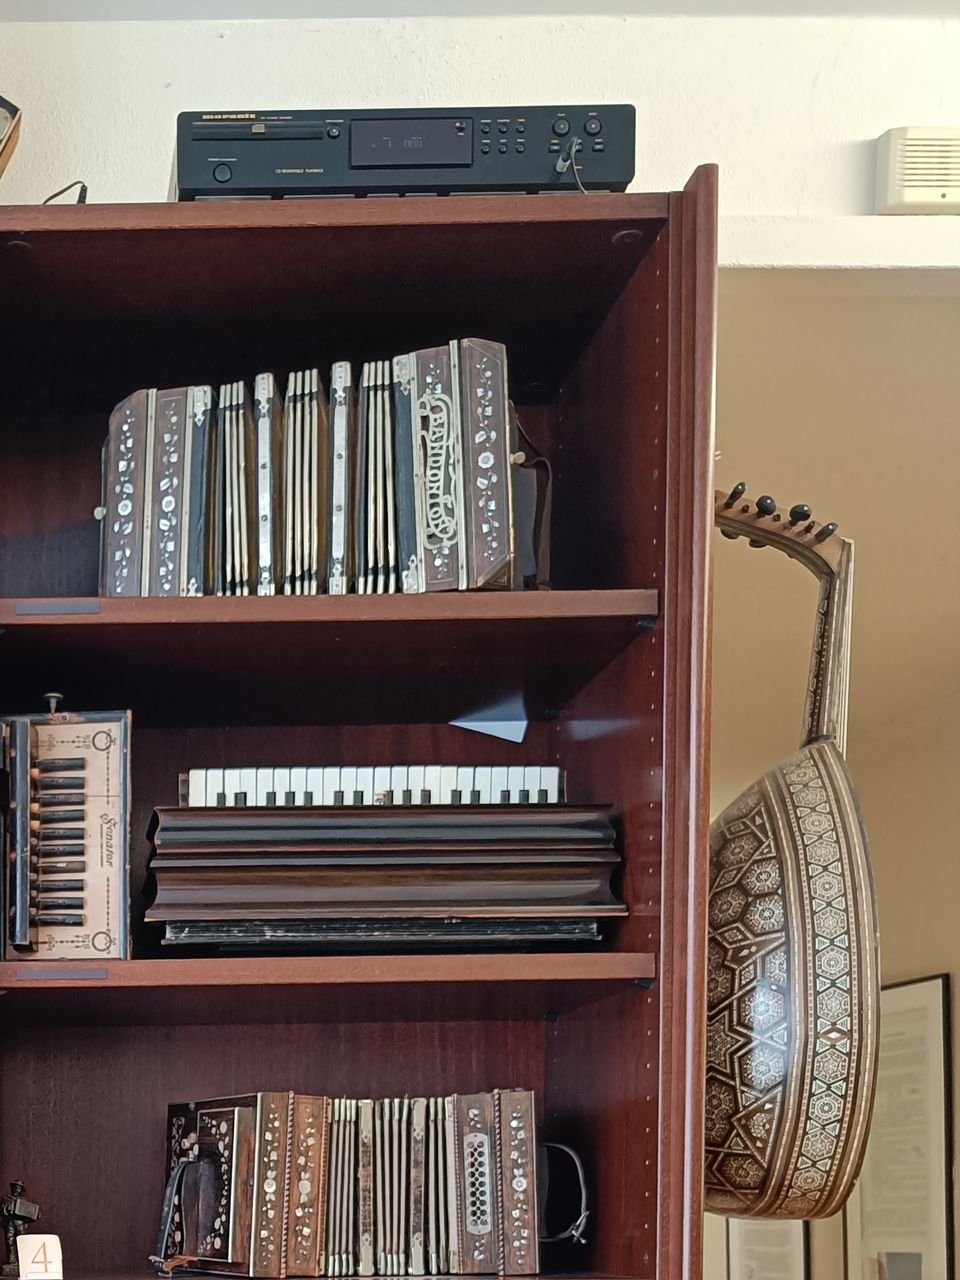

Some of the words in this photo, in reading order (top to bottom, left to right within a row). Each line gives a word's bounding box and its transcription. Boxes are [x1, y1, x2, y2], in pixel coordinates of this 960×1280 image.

[428, 412, 454, 533] BANDONION
[100, 813, 118, 868] Senator
[31, 1241, 53, 1273] 4
